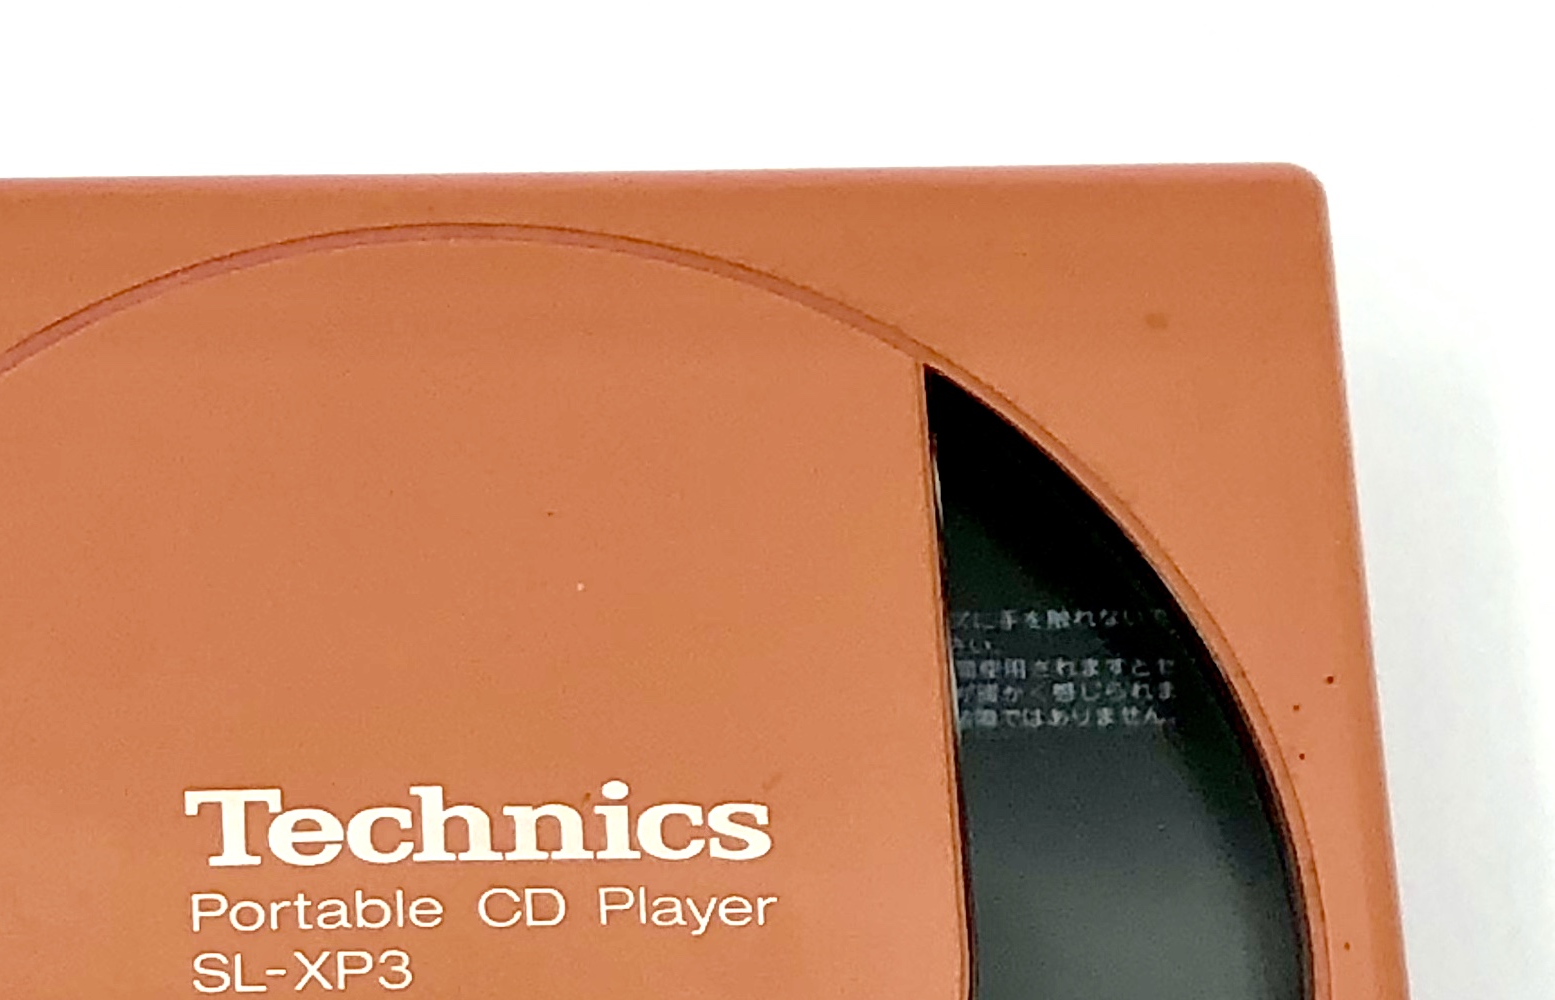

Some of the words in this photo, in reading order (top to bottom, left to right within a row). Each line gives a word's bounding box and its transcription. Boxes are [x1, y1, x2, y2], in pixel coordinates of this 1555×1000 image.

[184, 780, 772, 867] Technics
[191, 889, 444, 933] Portable
[477, 887, 566, 928] CD
[598, 886, 778, 936] Player
[192, 949, 413, 993] SL-XP3
